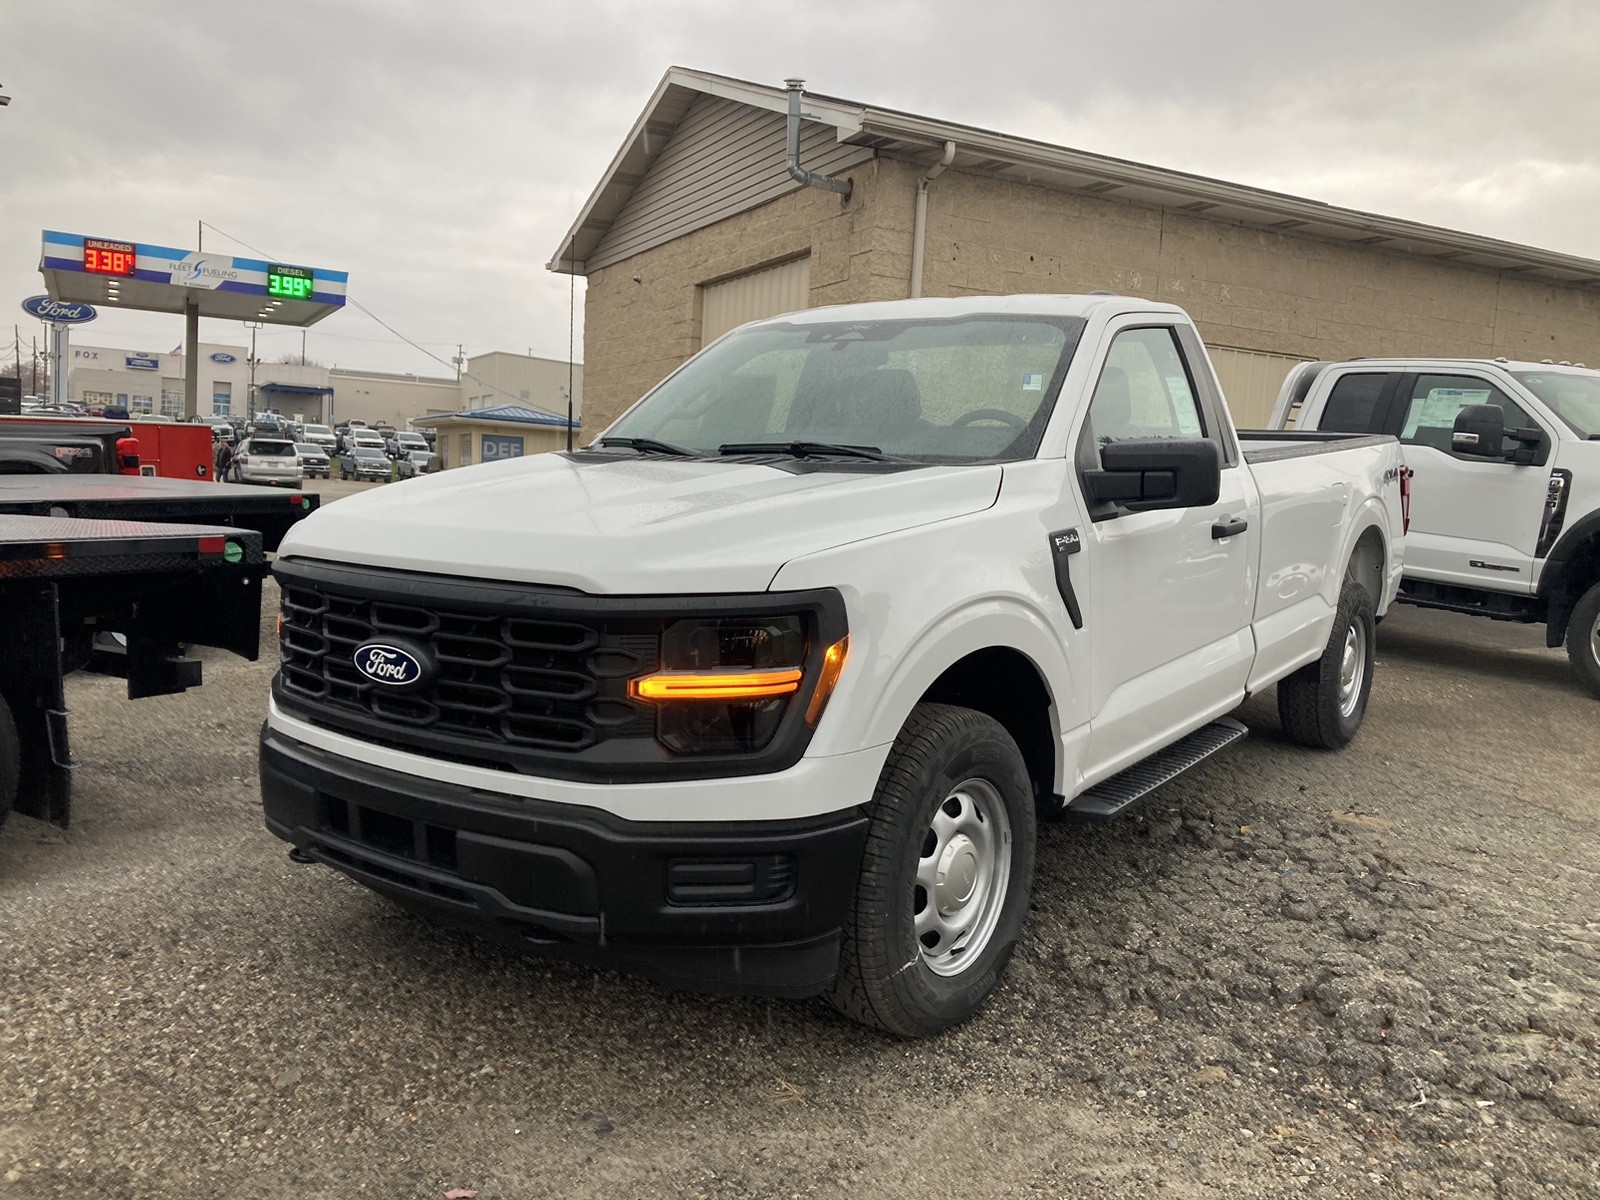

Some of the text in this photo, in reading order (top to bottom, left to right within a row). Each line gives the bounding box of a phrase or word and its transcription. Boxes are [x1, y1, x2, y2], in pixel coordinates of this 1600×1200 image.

[88, 240, 132, 252] UNLEADED
[169, 263, 193, 272] FLEET
[202, 268, 238, 278] FUELING
[277, 267, 305, 276] DIESEL
[37, 299, 82, 318] Ford
[75, 350, 99, 360] FOX
[55, 447, 93, 458] FX4
[483, 441, 521, 457] DEF
[366, 649, 407, 680] Ford
